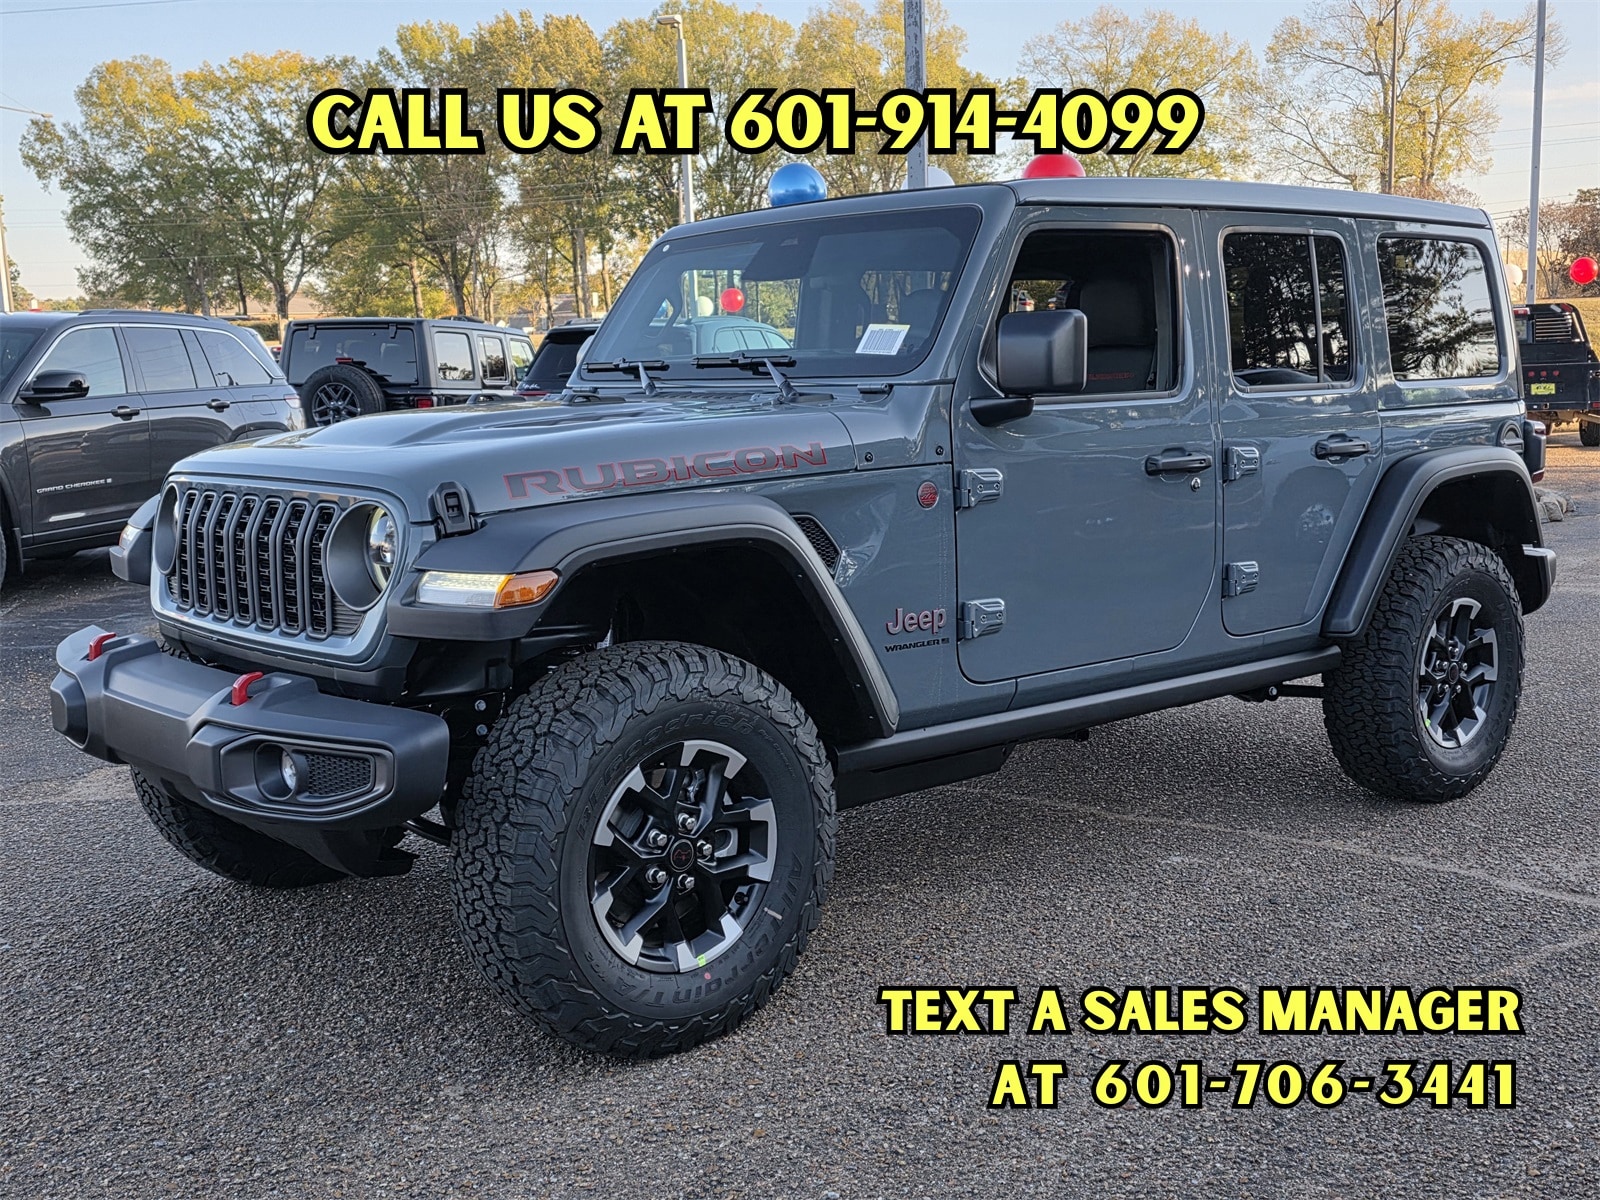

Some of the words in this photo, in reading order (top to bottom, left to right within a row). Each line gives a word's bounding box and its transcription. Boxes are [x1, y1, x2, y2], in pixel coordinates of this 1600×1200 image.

[503, 442, 827, 500] RUBICON
[36, 485, 64, 494] GRAND
[65, 479, 105, 489] CHEROKEE
[885, 607, 947, 636] Jeep
[884, 639, 940, 653] WRANGLER
